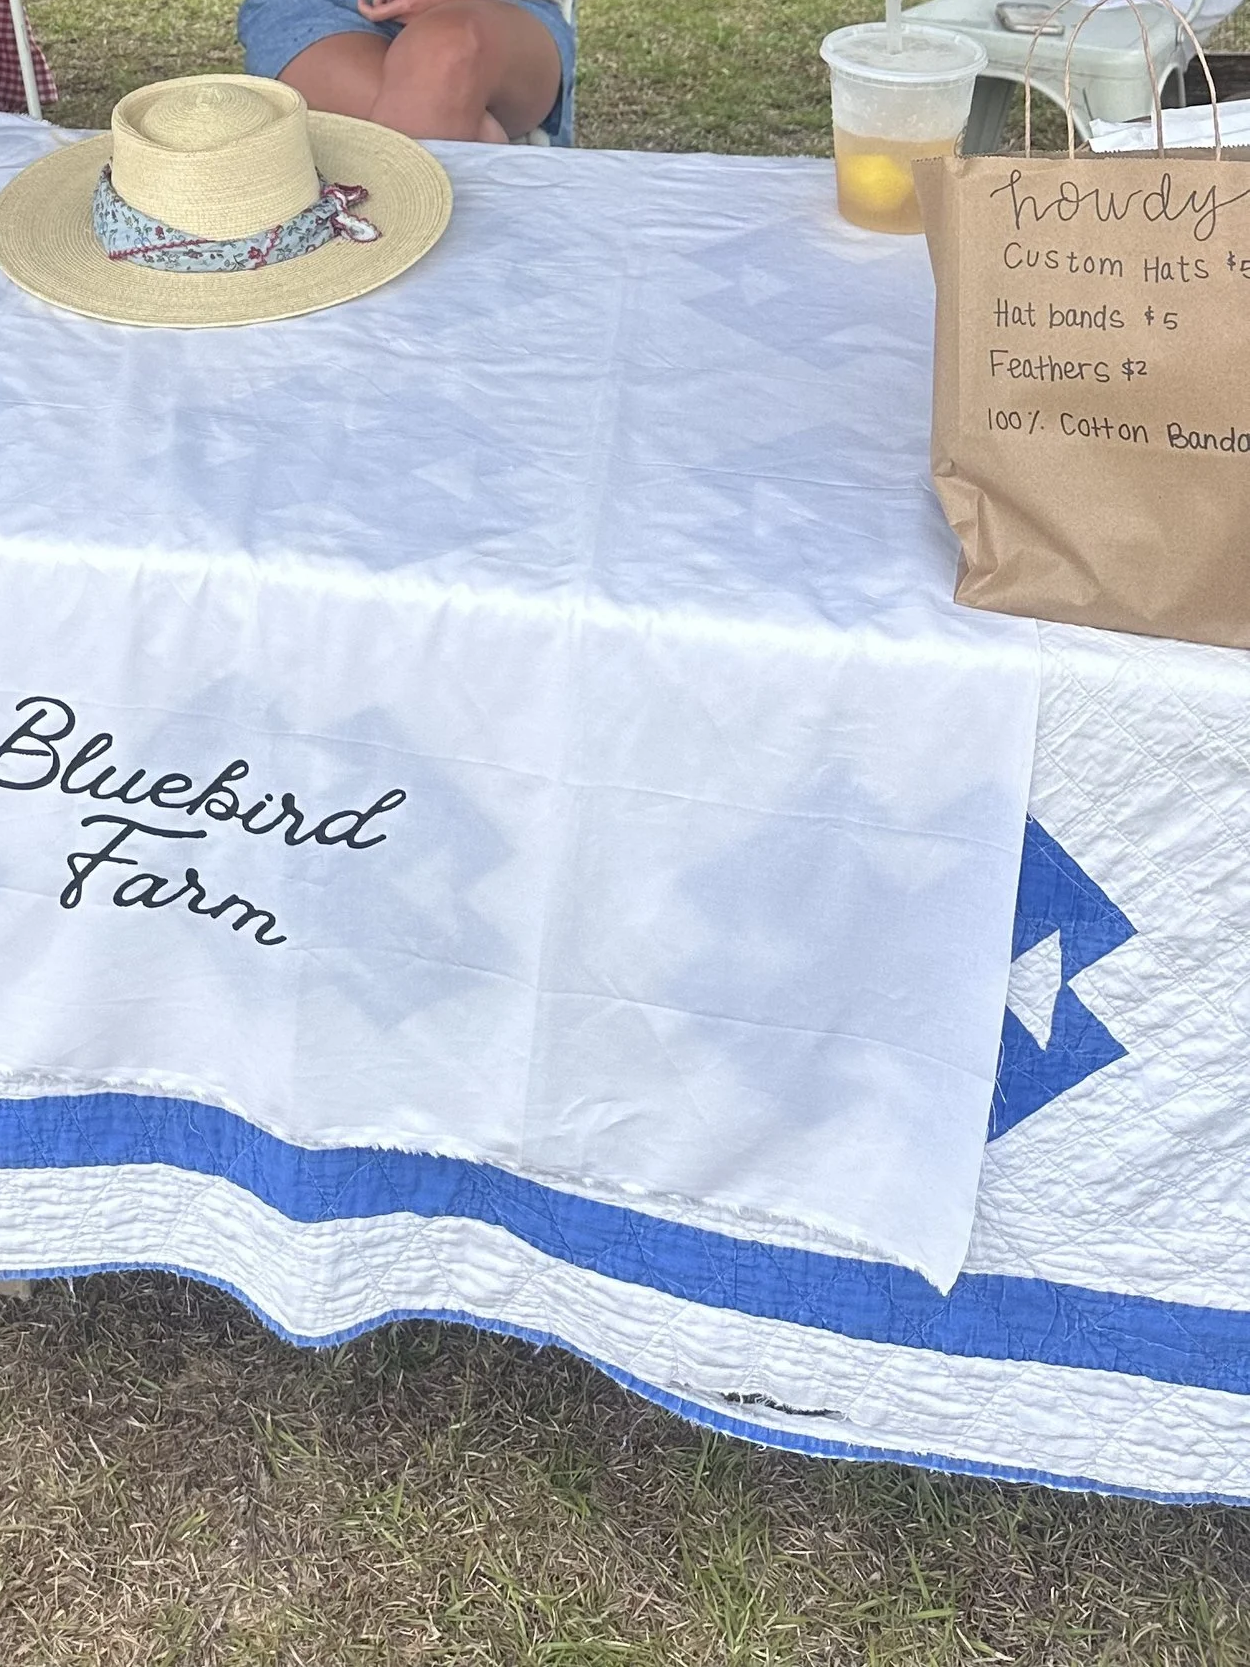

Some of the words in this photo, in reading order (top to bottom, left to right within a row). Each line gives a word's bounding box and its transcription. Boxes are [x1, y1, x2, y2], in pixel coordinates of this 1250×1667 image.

[990, 169, 1250, 241] howdy
[1004, 242, 1123, 277] Custom
[1144, 256, 1209, 283] Hats
[993, 298, 1036, 328] Hat
[1049, 303, 1125, 331] bands
[990, 349, 1110, 383] Feathers
[1121, 357, 1148, 381] $2
[988, 408, 1045, 434] 100%
[1060, 413, 1149, 443] Cotton
[1167, 422, 1250, 452] Banda
[60, 814, 287, 946] Farm
